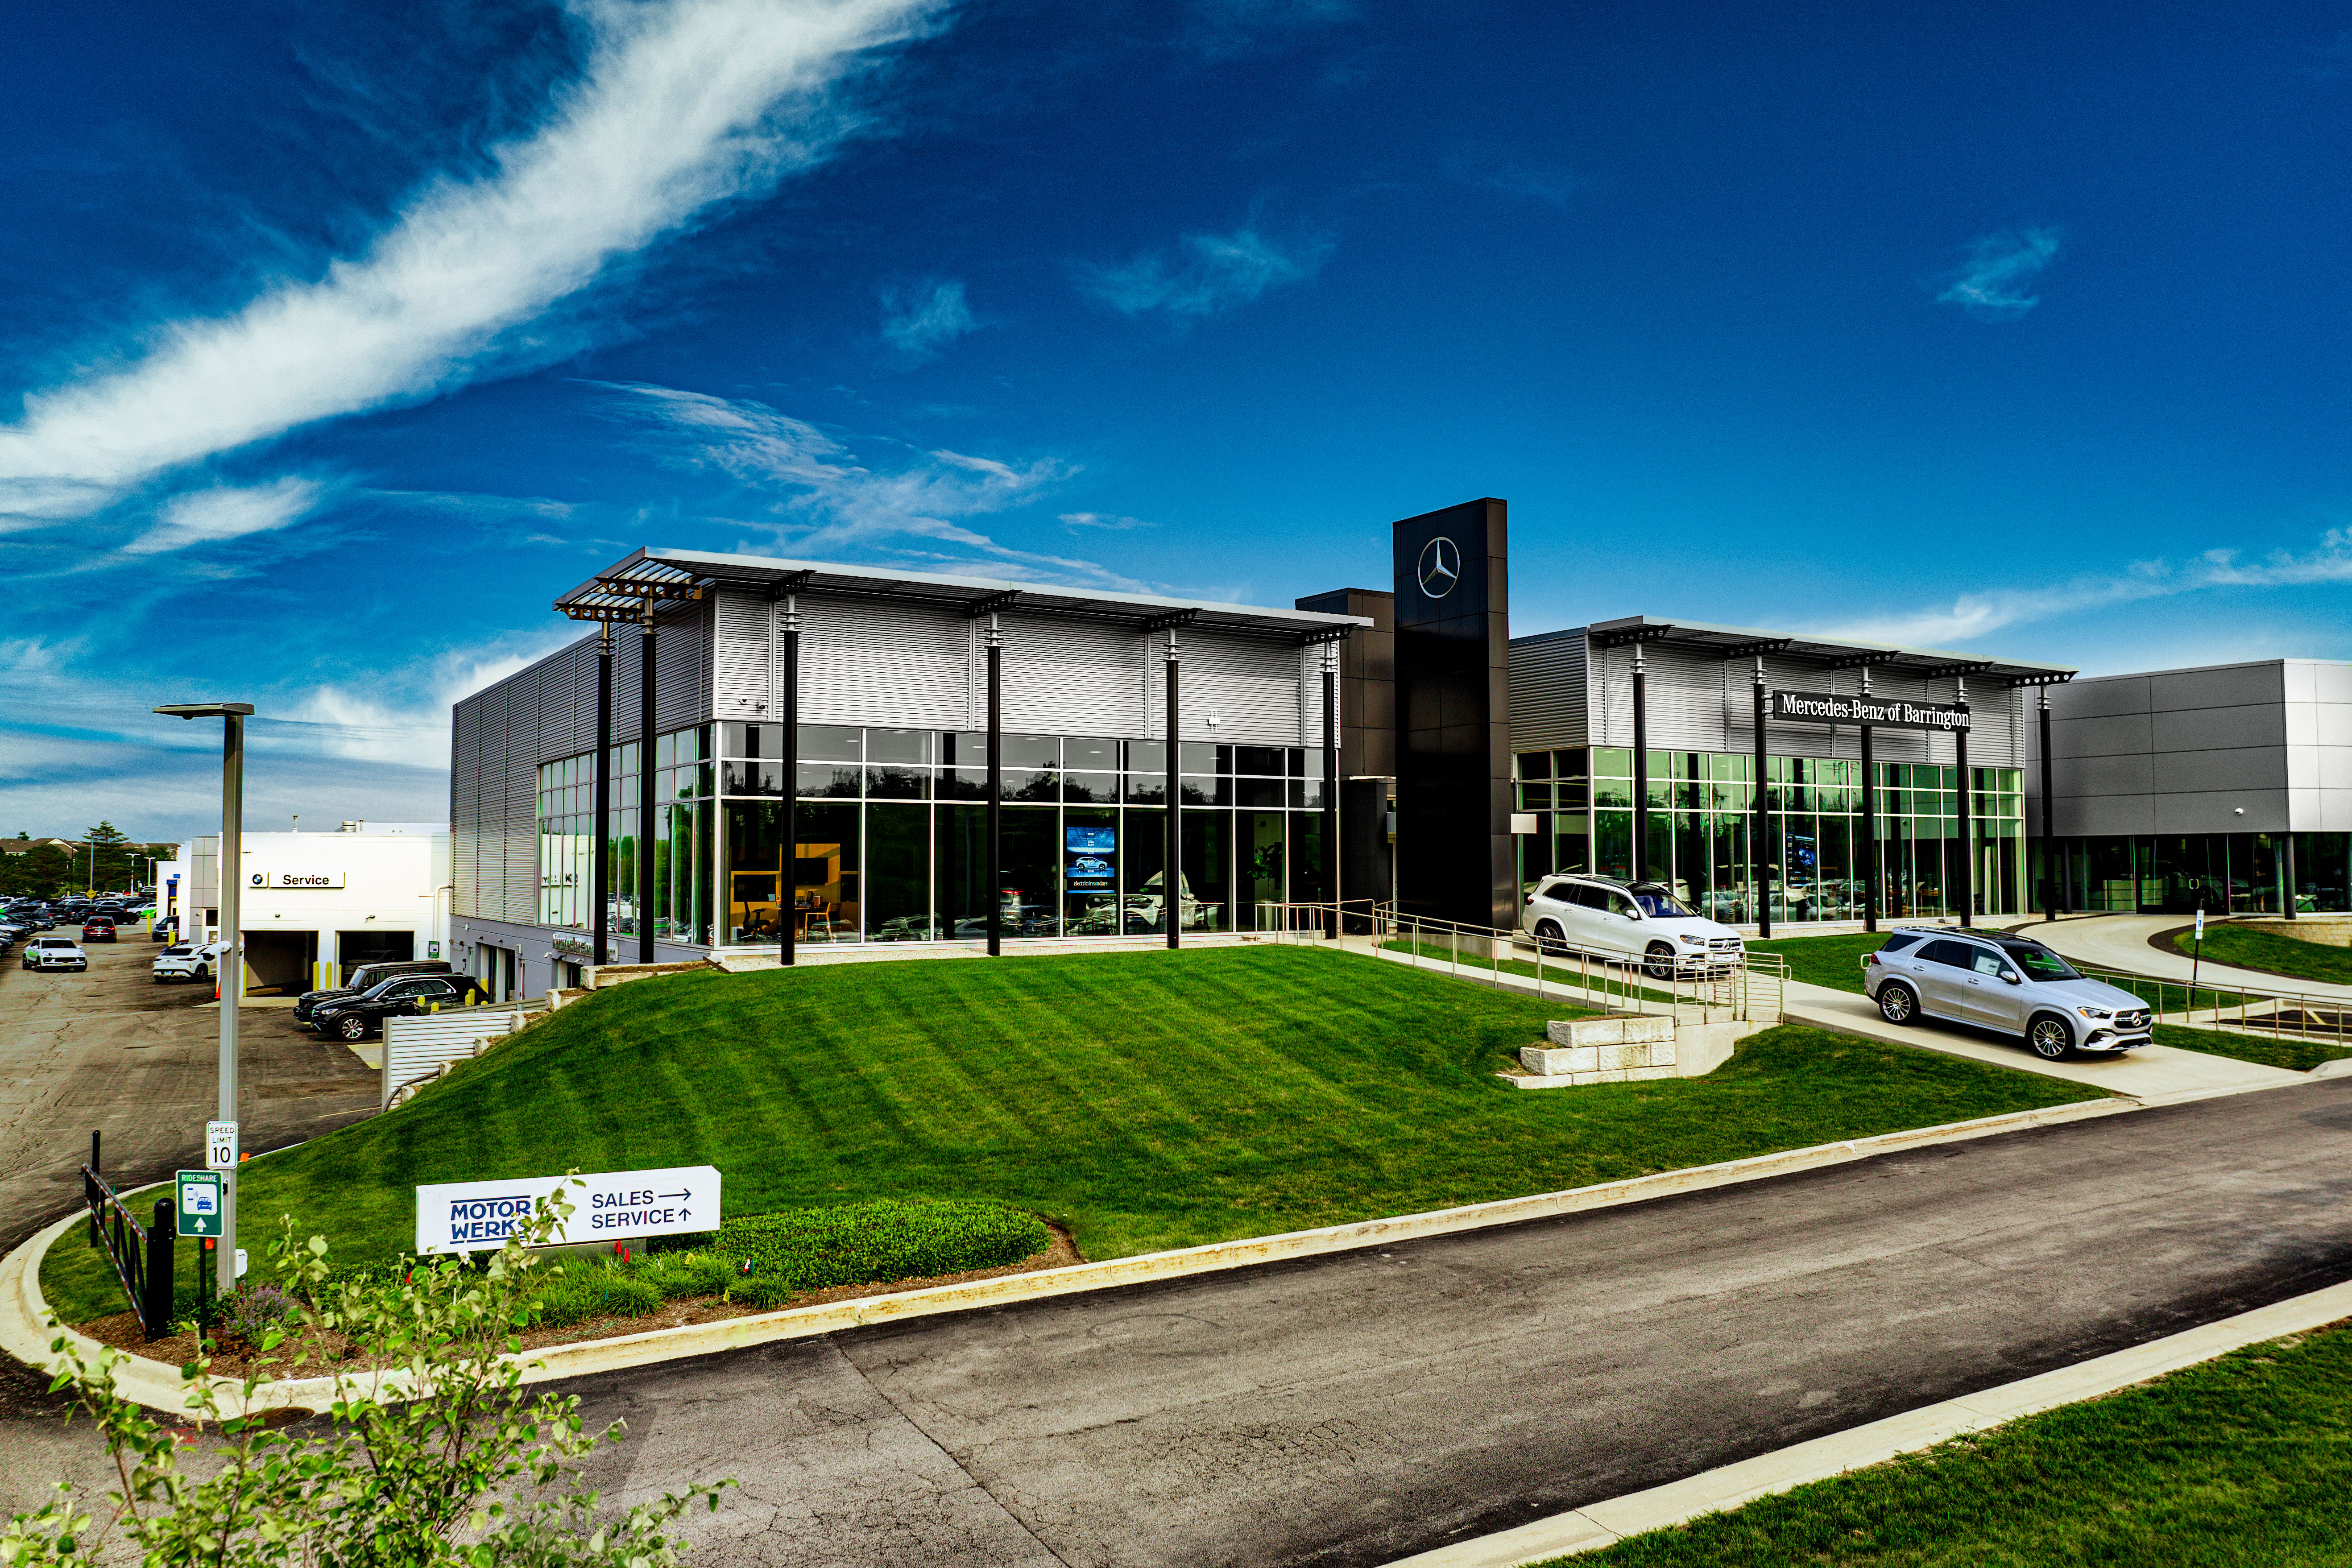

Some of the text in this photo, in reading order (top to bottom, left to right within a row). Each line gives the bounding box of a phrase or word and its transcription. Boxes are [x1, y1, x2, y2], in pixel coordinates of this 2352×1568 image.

[1782, 694, 1969, 730] Mercedes-Benz of Barrington
[283, 874, 329, 885] Service
[214, 1147, 231, 1163] 10
[182, 1174, 217, 1183] RIDESHARE
[592, 1190, 654, 1208] SALES
[451, 1200, 531, 1221] MOTOR
[592, 1208, 674, 1229] SERVICE
